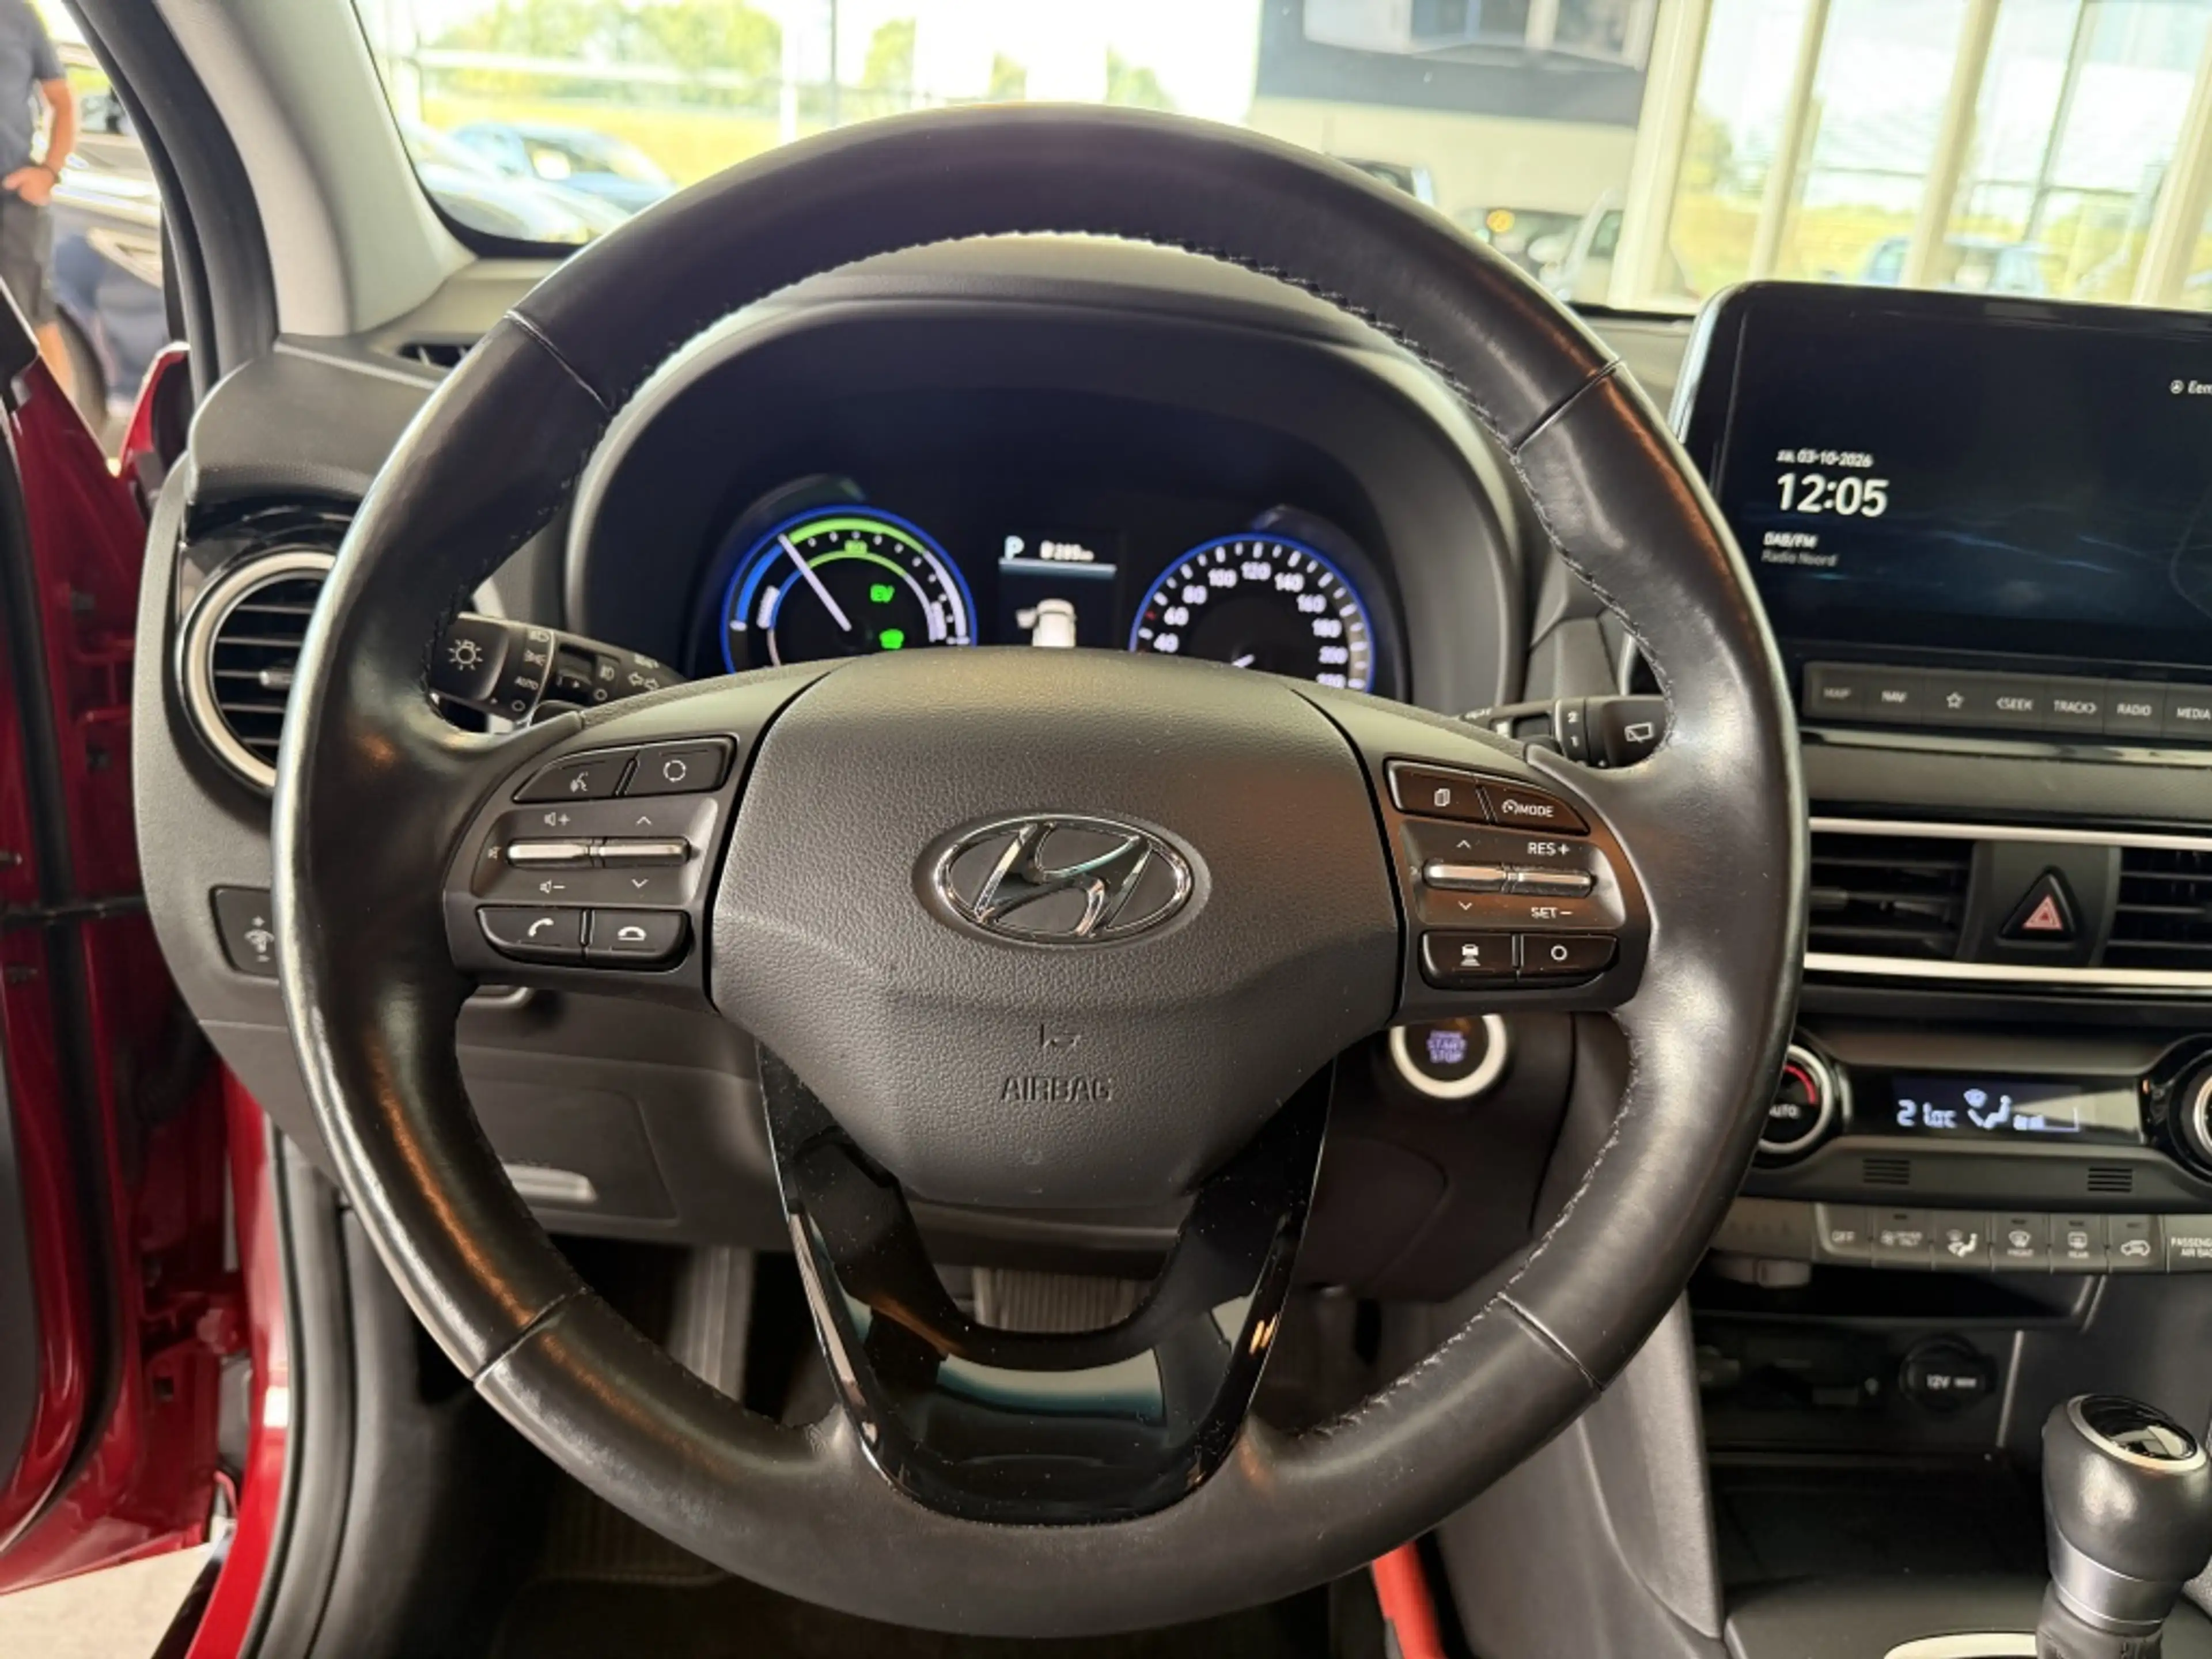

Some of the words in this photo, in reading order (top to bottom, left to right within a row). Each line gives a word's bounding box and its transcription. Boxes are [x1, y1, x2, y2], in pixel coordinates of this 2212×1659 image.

[1797, 448, 1873, 468] 03-10-2026
[1777, 472, 1890, 517] 12:05
[1004, 535, 1025, 560] P
[1763, 531, 1818, 548] DAB/FM
[1208, 569, 1237, 588] 100
[1241, 561, 1271, 581] 120
[1275, 573, 1304, 592] 140
[1182, 585, 1207, 604] 80
[1297, 594, 1327, 613] 160
[1164, 607, 1189, 626] 60
[1312, 618, 1342, 638] 180
[1153, 633, 1179, 653] 40
[1567, 710, 1579, 724] 2
[2116, 702, 2153, 717] RADIO
[2177, 707, 2211, 720] MEDIA
[1570, 736, 1579, 748] 1
[1517, 804, 1554, 818] MODE
[999, 1076, 1113, 1102] AIRBAG
